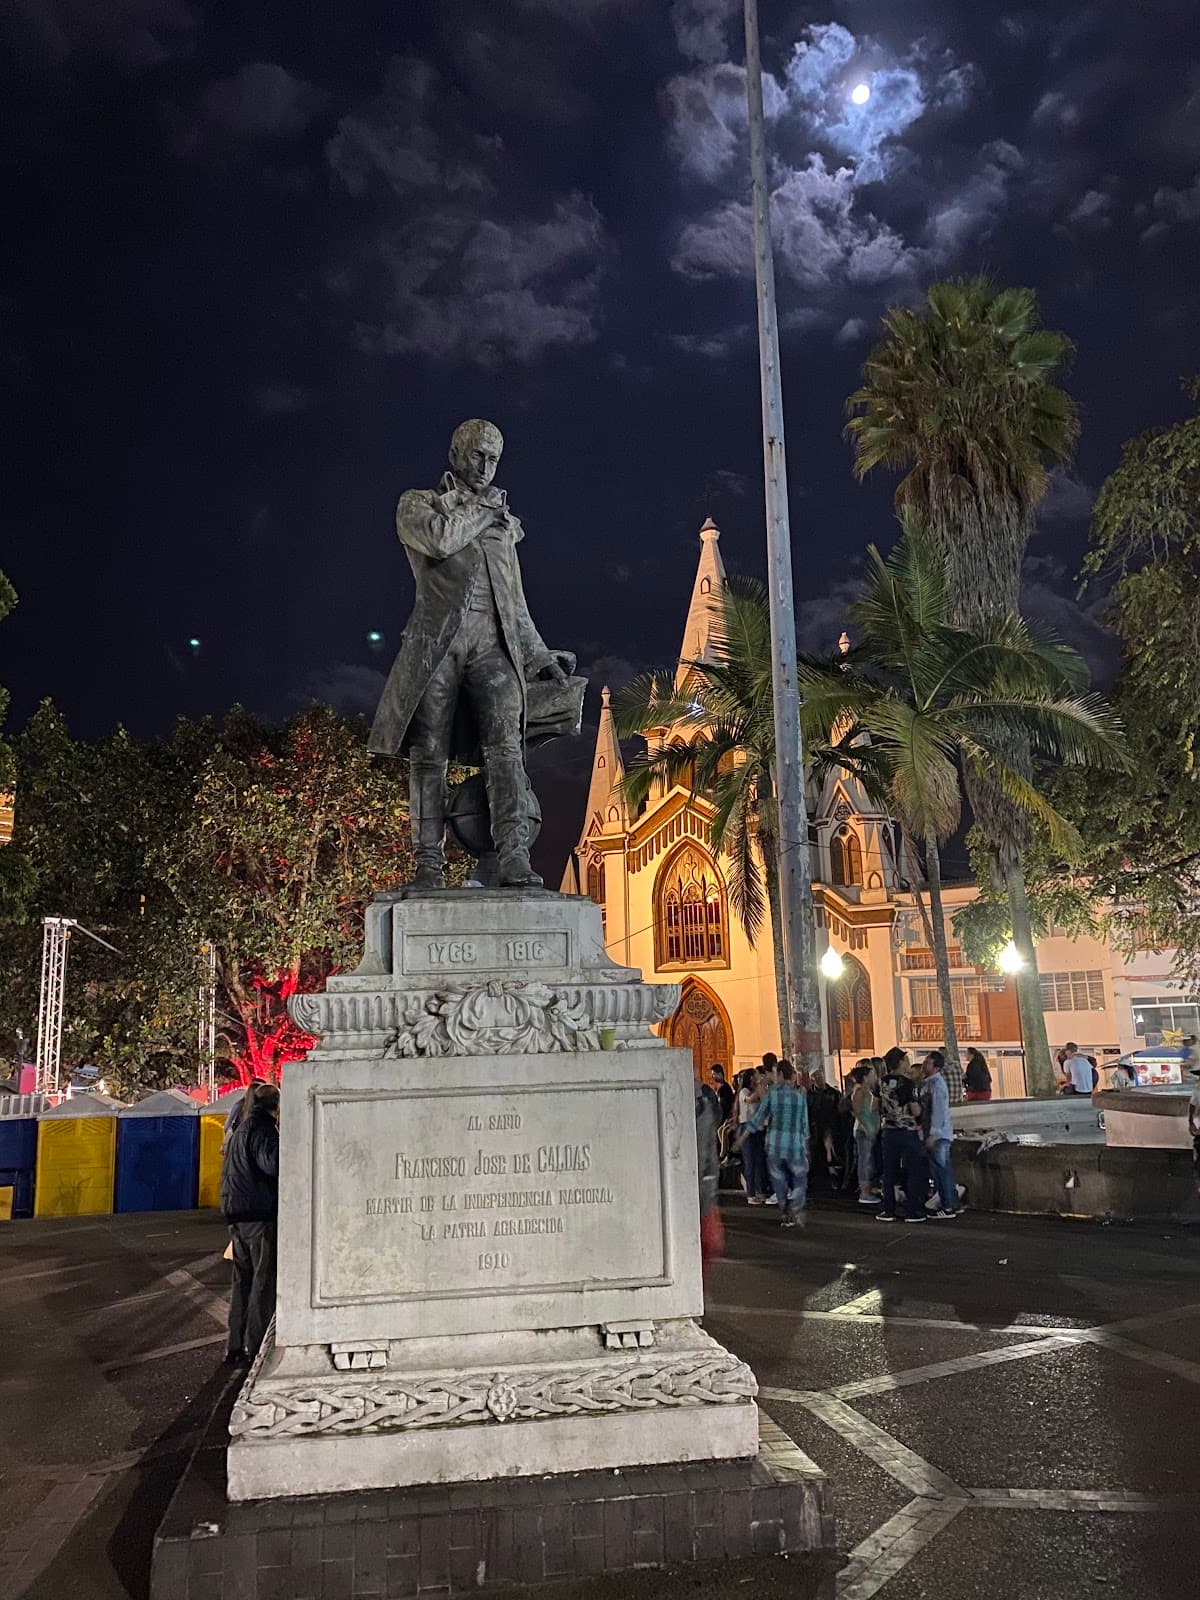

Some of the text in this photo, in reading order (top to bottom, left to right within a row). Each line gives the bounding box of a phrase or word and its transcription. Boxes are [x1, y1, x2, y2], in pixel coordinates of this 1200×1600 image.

[428, 940, 545, 964] 1768 1816
[467, 1114, 521, 1131] AL SABIO
[395, 1144, 591, 1179] FRANCISCO JOSE DE CALDAS
[366, 1187, 614, 1215] MARTIR DE LA INDEPENDENCIA NACIONAL
[421, 1217, 565, 1240] LA PATRIA AGRADECIDA
[478, 1253, 511, 1270] 1910
